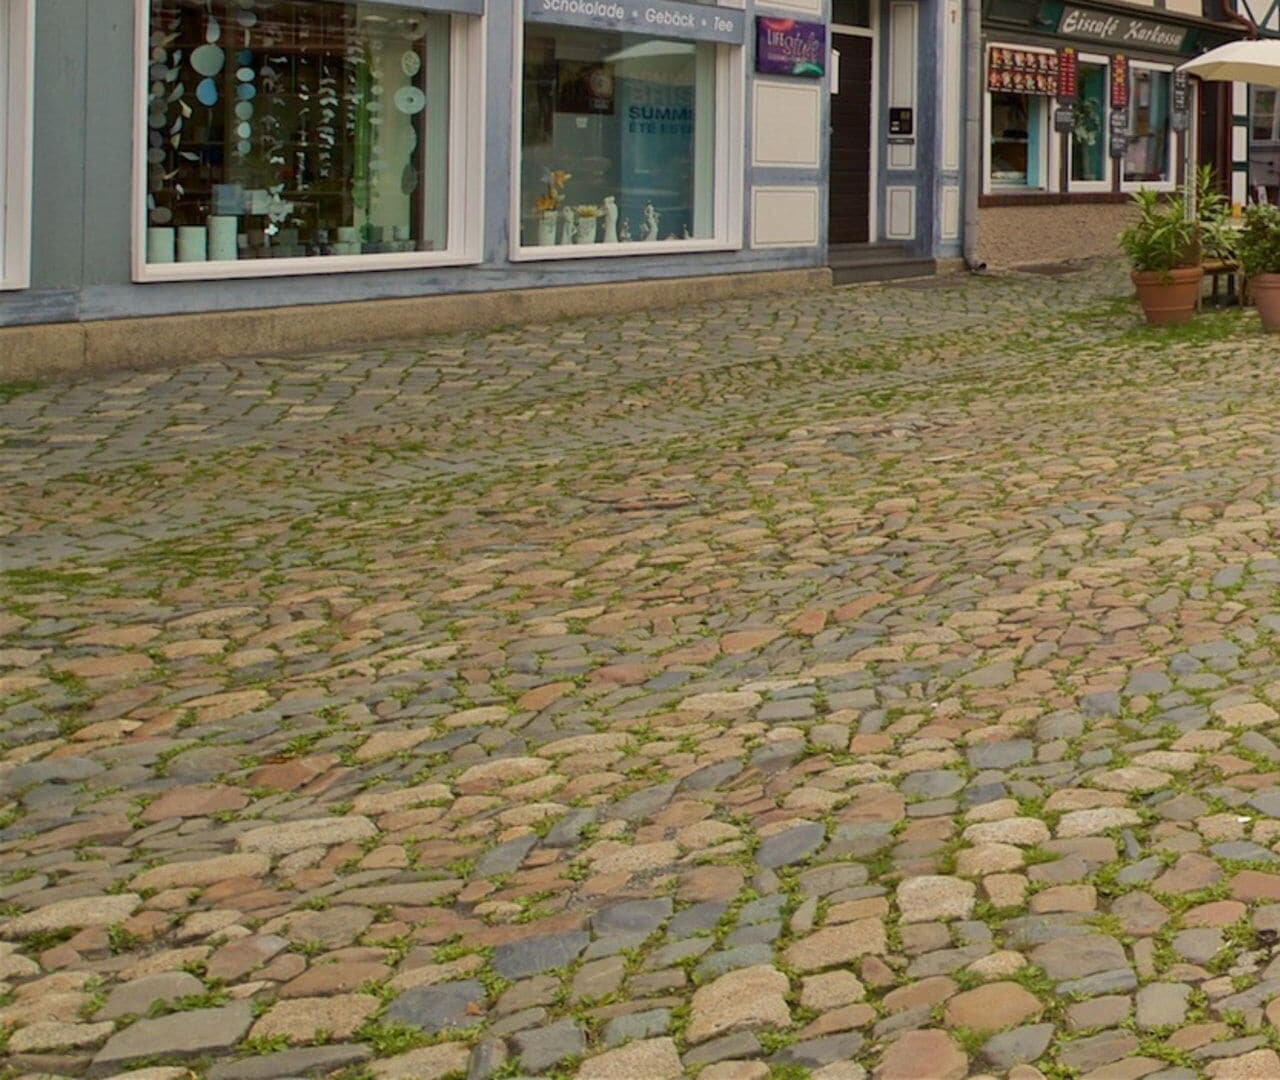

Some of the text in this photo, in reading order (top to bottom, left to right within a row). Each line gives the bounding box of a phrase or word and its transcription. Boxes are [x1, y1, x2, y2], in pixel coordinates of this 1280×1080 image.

[645, 7, 696, 27] Gebäck
[713, 16, 735, 32] Tee
[1063, 10, 1120, 38] Eiscafé
